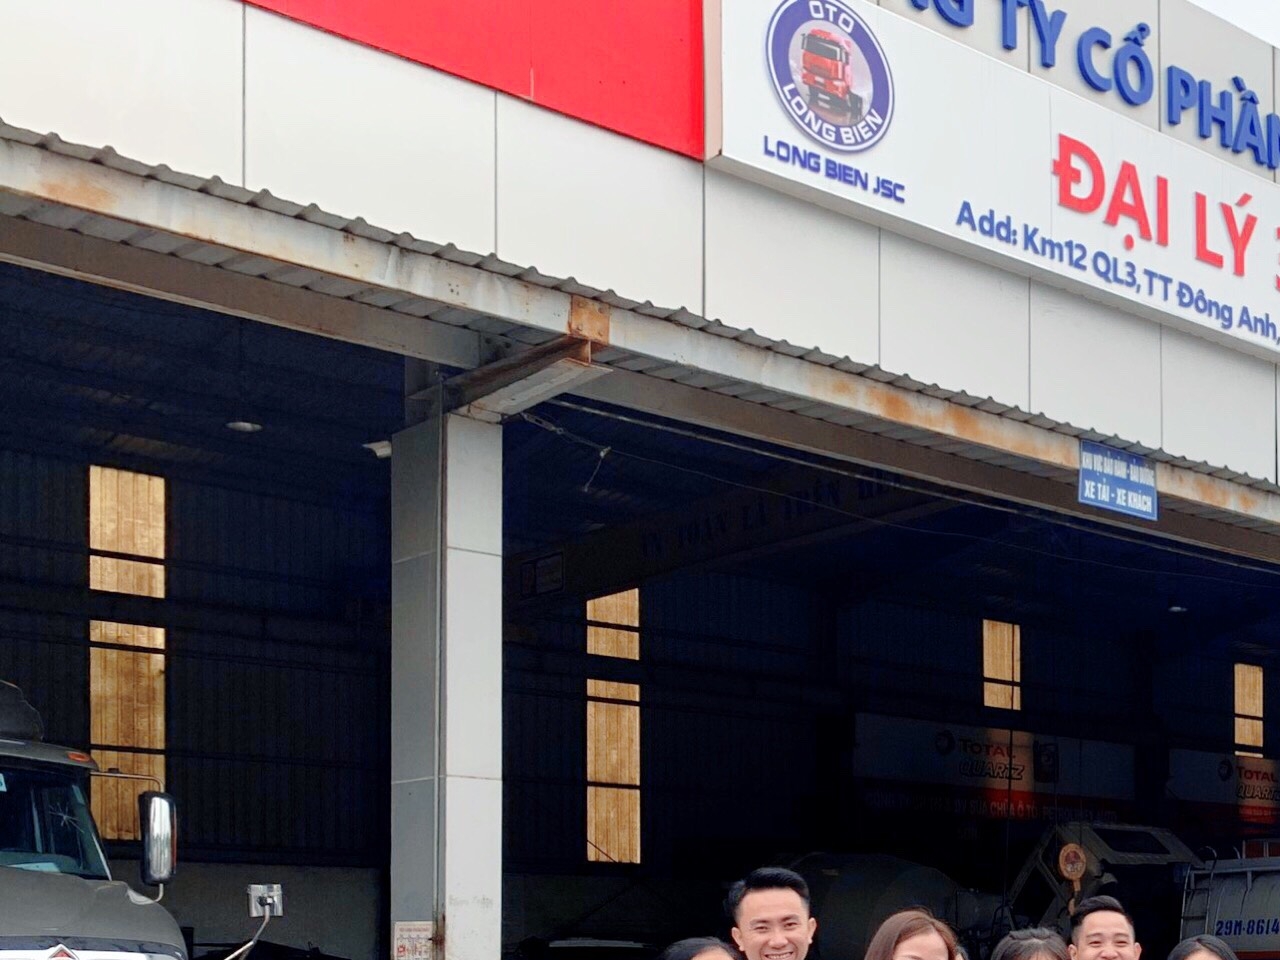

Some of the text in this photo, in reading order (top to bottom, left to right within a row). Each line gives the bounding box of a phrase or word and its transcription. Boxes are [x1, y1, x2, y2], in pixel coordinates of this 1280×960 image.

[809, 1, 854, 34] OTO
[1077, 22, 1154, 106] CỔ
[783, 83, 883, 144] LONG BIEN
[763, 135, 905, 204] LONG BIEN JSC
[1052, 133, 1169, 251] ĐẠI
[1195, 191, 1258, 277] LÝ
[956, 200, 1018, 246] Add:
[1023, 223, 1087, 271] Km12
[1177, 281, 1233, 330] Đông
[960, 738, 1016, 759] TOTAL
[960, 760, 1025, 780] QUARTZ
[1236, 765, 1279, 783] TOTAL
[1215, 918, 1280, 936] 29M-8614
